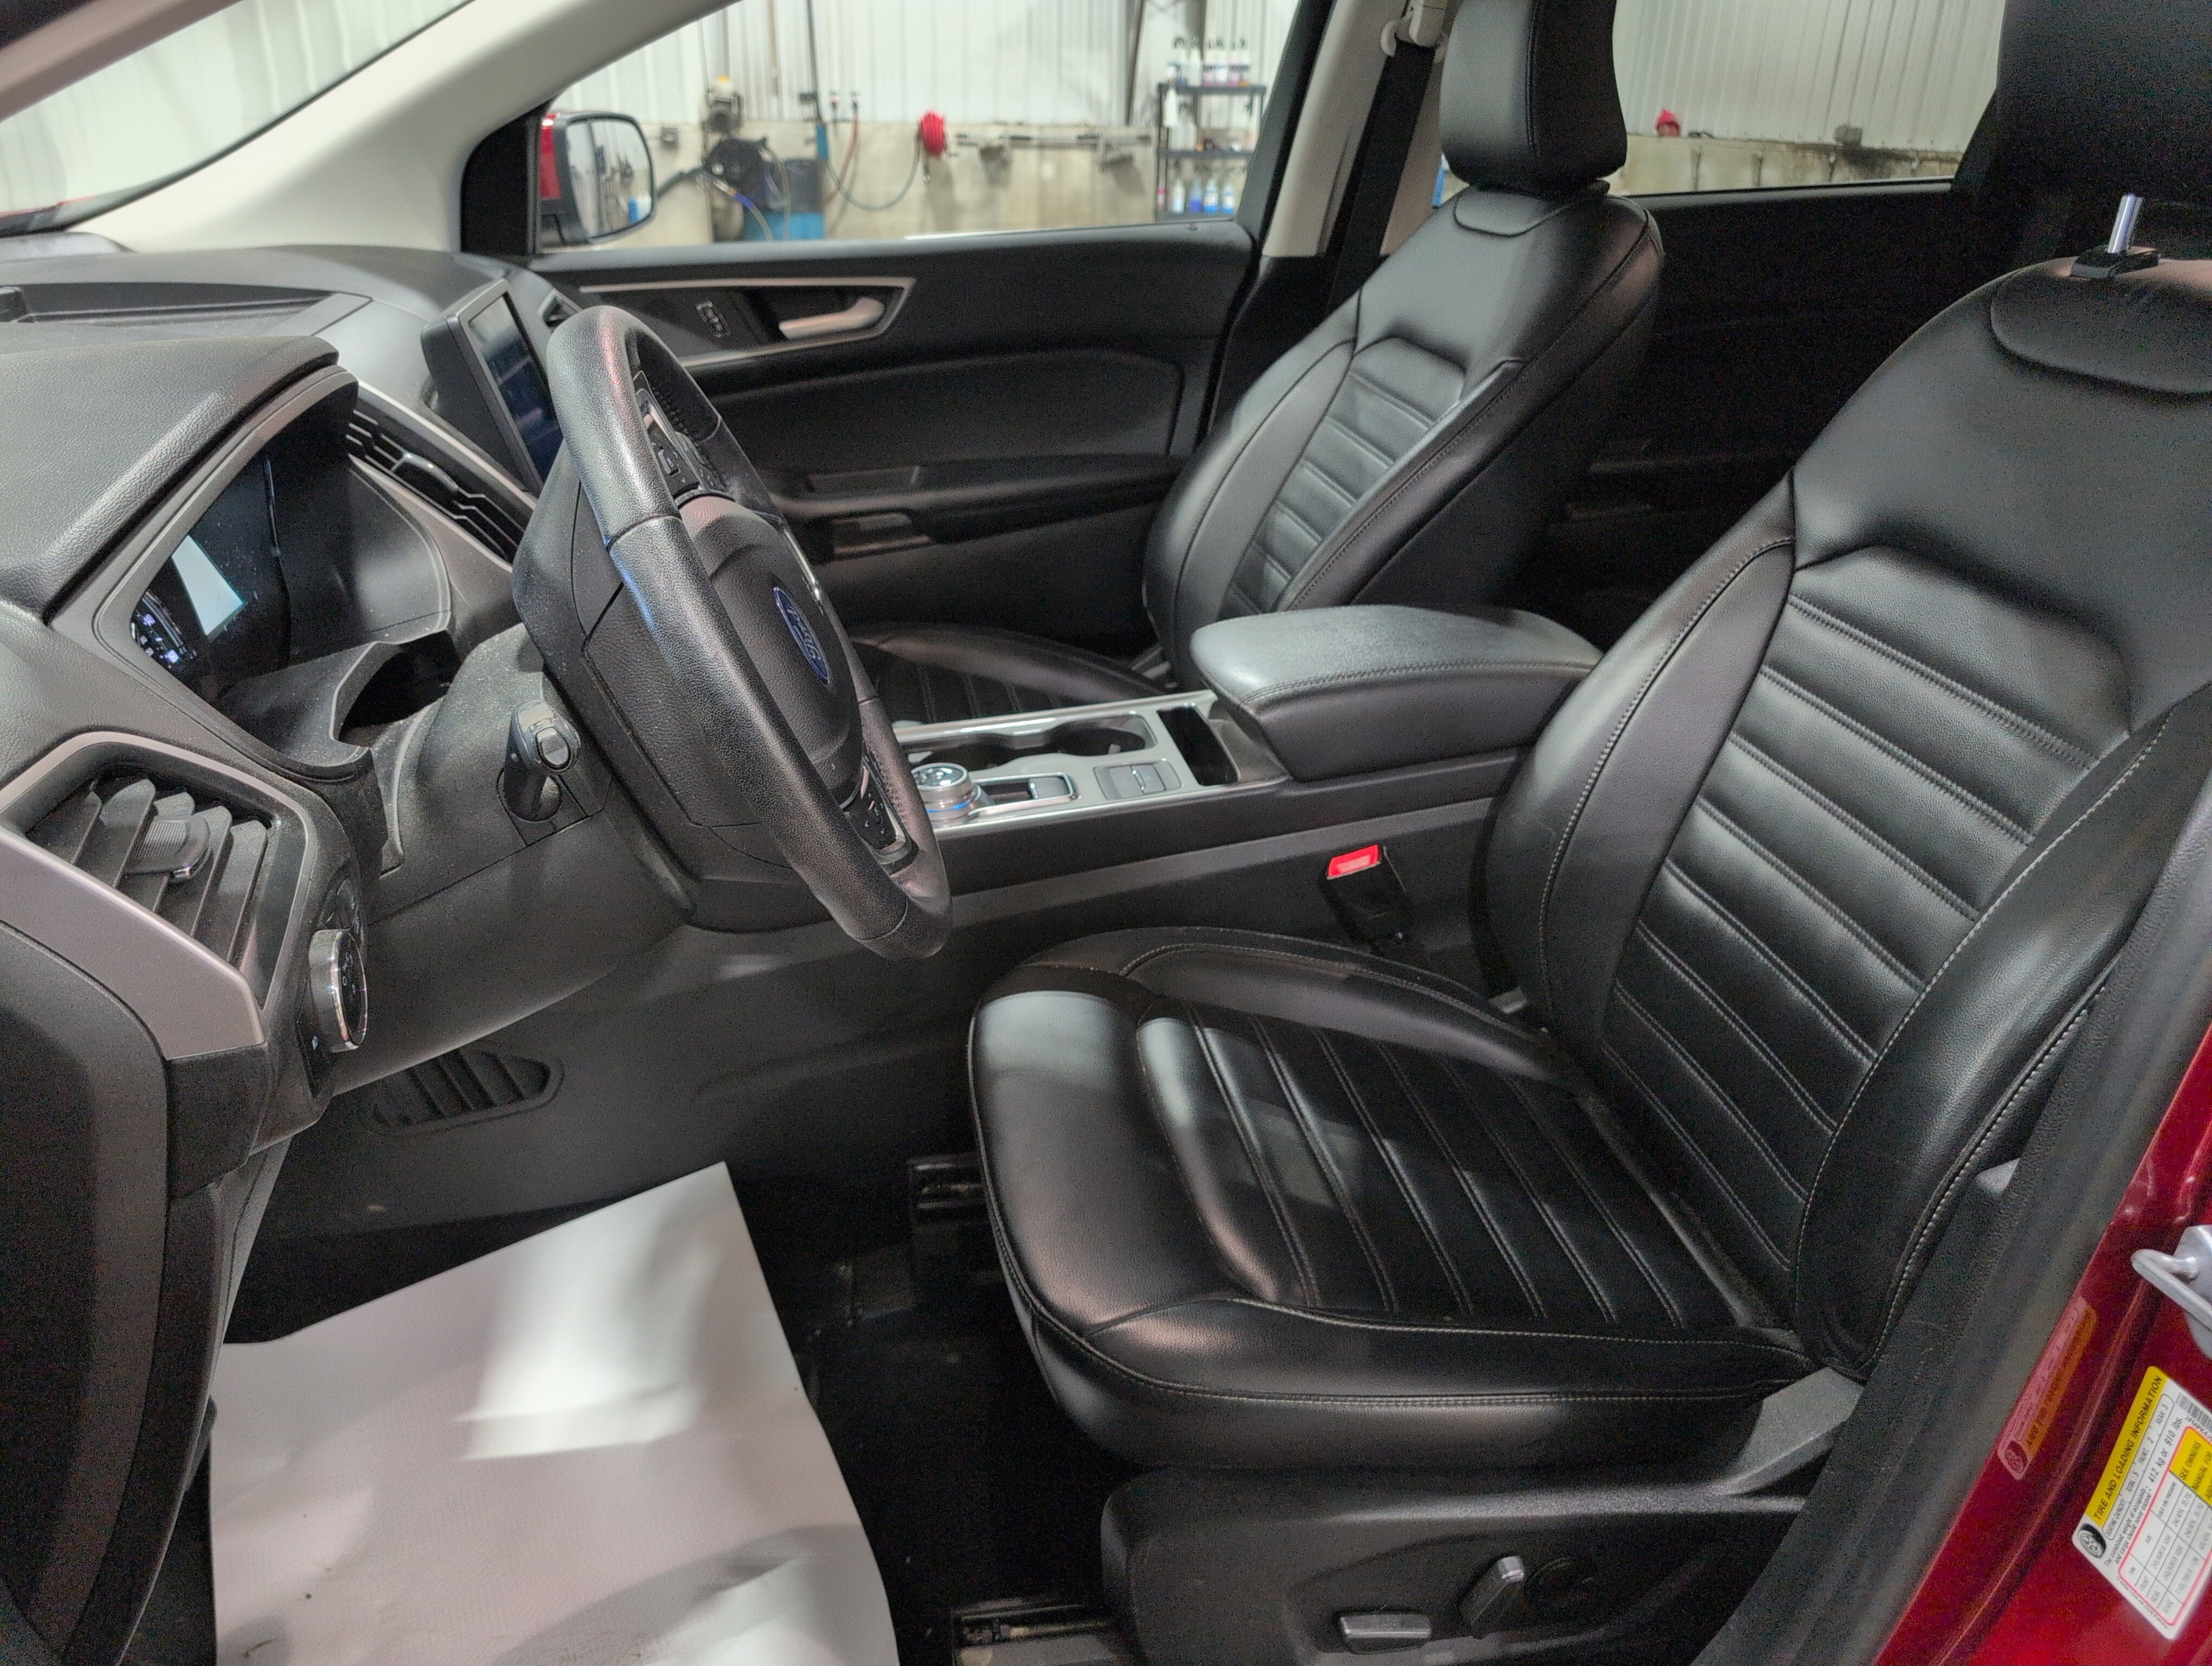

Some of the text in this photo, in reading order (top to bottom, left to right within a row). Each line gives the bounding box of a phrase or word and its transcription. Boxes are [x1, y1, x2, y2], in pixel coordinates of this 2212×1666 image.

[787, 607, 821, 661] Ford
[2164, 1430, 2176, 1447] 910
[2095, 1375, 2163, 1522] TIRE AND LOADING INFORMATION
[2162, 1449, 2168, 1458] or
[2155, 1455, 2166, 1470] kg
[2147, 1467, 2159, 1484] 412
[2179, 1465, 2190, 1482] SEE
